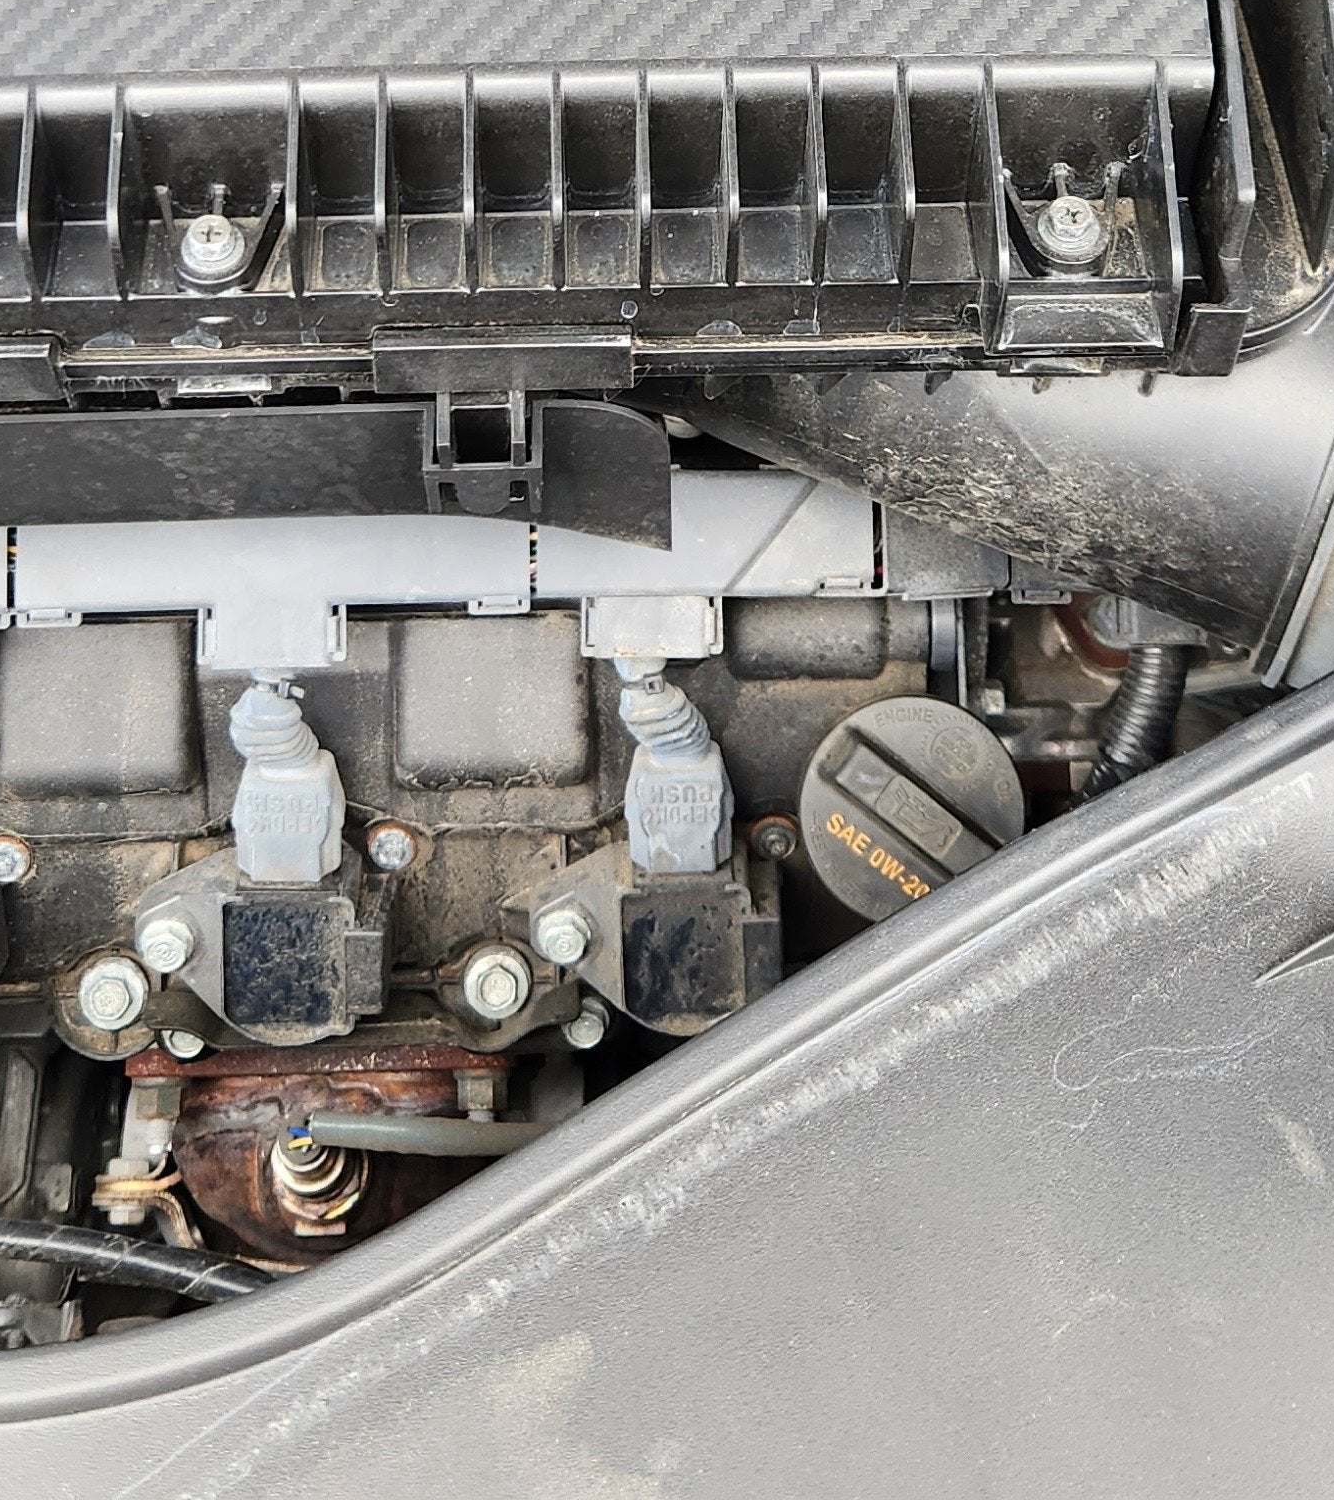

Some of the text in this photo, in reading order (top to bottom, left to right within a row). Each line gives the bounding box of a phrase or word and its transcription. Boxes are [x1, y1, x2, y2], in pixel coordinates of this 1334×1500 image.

[875, 707, 935, 728] ENGINE
[651, 784, 713, 804] PUSH
[826, 812, 871, 856] SAE
